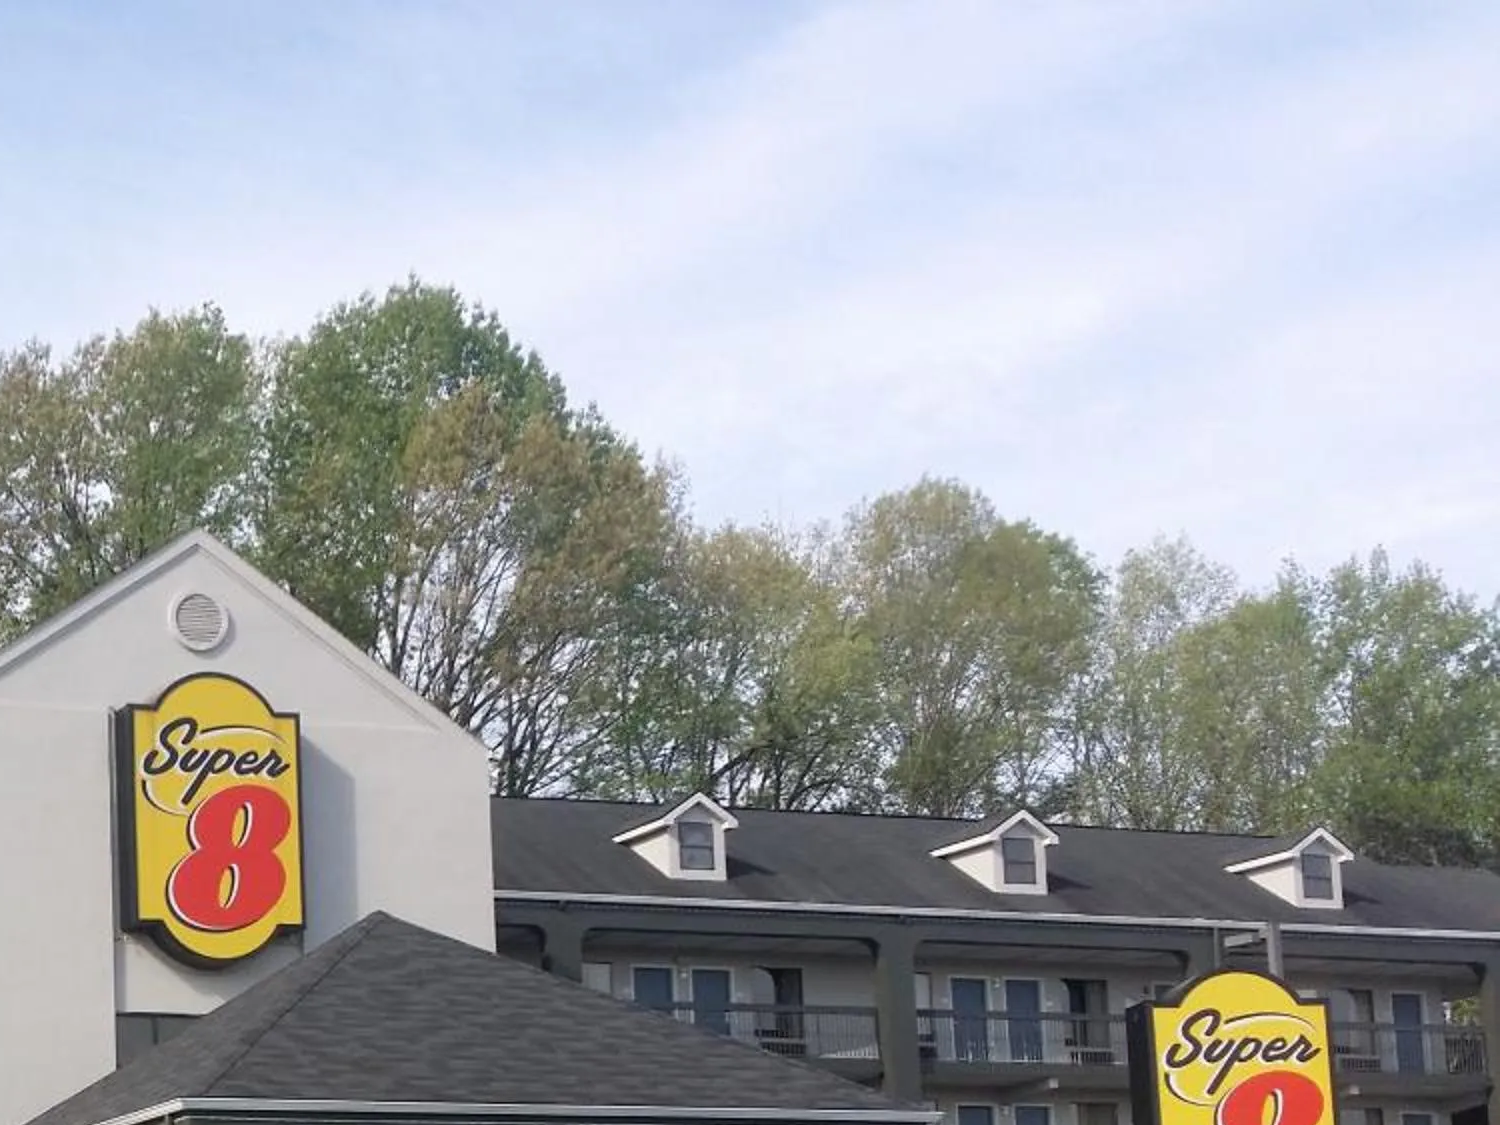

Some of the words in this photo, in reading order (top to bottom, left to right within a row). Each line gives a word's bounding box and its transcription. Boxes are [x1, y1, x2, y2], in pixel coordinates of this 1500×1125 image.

[143, 716, 290, 805] Super
[166, 783, 292, 933] 8
[1164, 1008, 1321, 1095] Super
